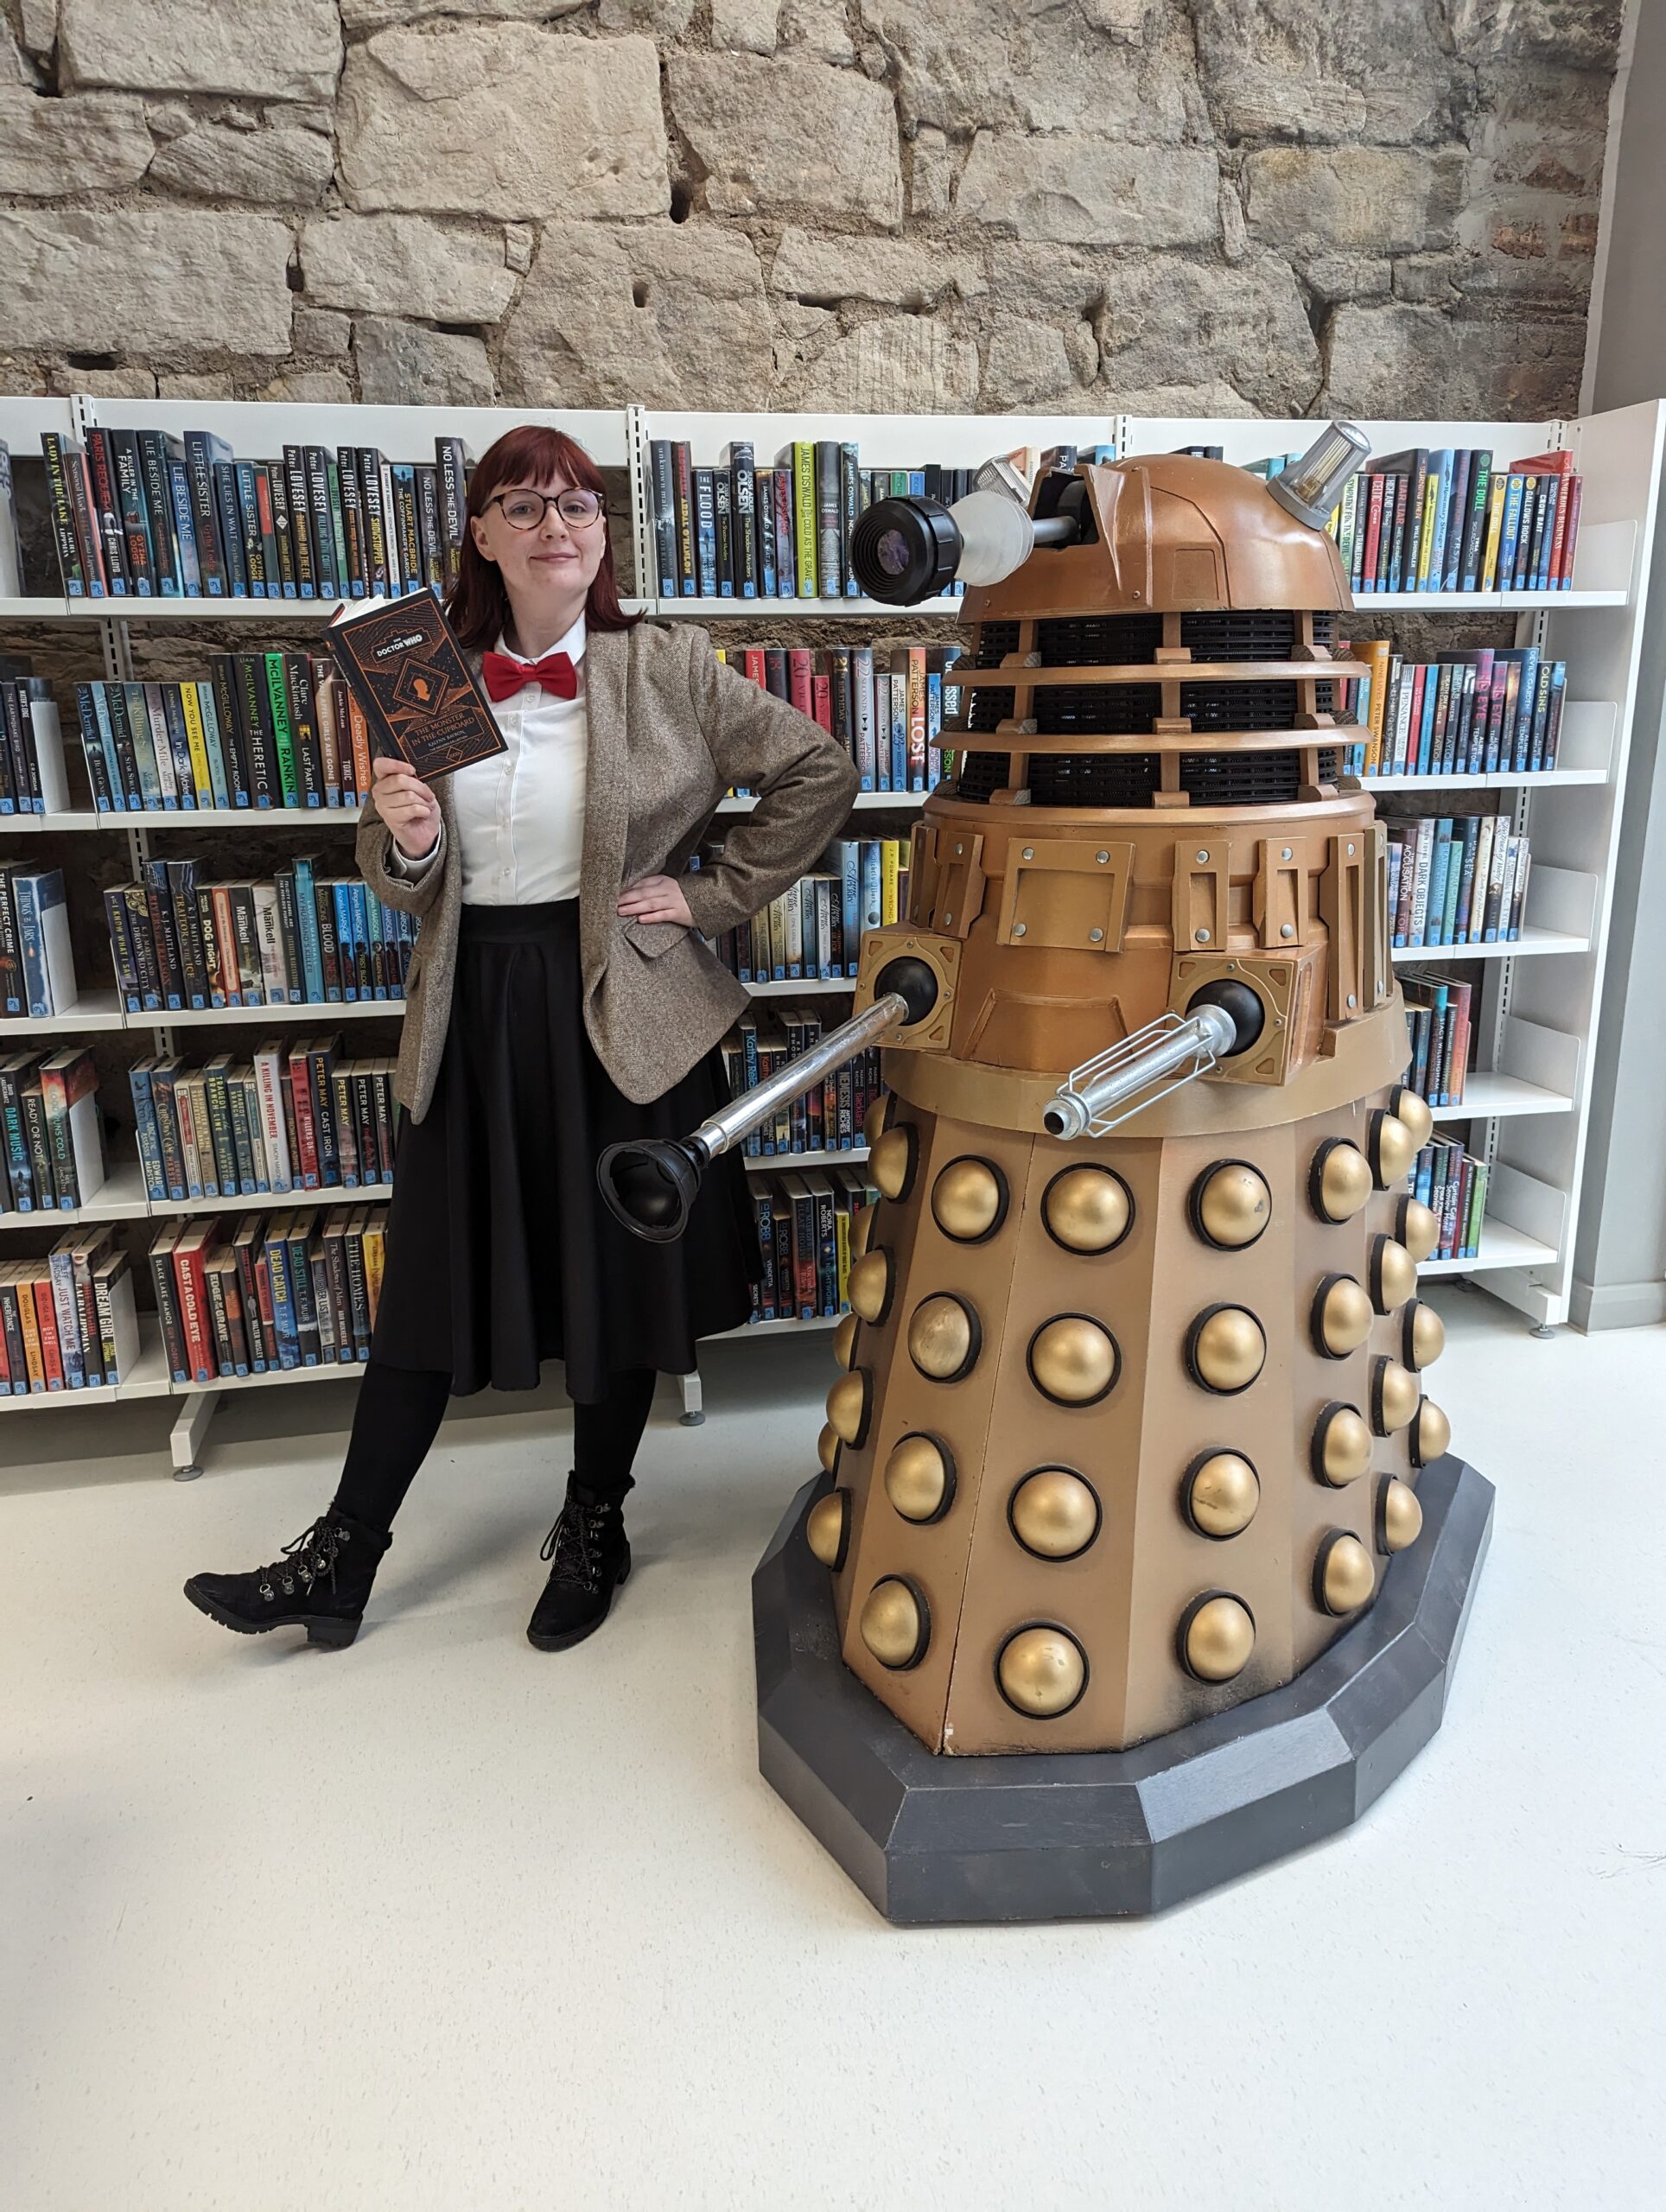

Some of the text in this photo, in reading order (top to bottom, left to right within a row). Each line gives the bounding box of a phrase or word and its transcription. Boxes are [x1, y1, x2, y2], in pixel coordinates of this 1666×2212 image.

[47, 436, 57, 464] LADY
[91, 433, 104, 465] PARIS
[145, 441, 154, 457] LIE
[442, 446, 452, 463] NO
[118, 455, 130, 493] FAMILY
[147, 460, 159, 496] BESIDE
[173, 467, 182, 480] LIE
[192, 442, 210, 517] LITTLE SISTER
[290, 471, 306, 512] LOVESEY
[342, 469, 356, 509] LOVESEY
[443, 467, 455, 490] LESS
[738, 470, 748, 514] OLSEN
[800, 447, 811, 507] JAMES OSWALD
[1371, 481, 1383, 502] CELTIC
[1474, 470, 1488, 512] THE DOLL
[154, 499, 163, 515] ME
[176, 484, 188, 520] BESIDE
[242, 470, 257, 536] LITTLE SISTER
[274, 480, 285, 510] LOVESEY
[311, 473, 327, 513] LOVESEY
[365, 474, 380, 517] LOVESEY
[700, 486, 712, 530] FLOOD
[1384, 480, 1395, 507] HIGHLAND
[1396, 479, 1408, 524] LIAR LIAR
[1523, 491, 1534, 524] GALLOWS
[1555, 473, 1569, 550] DANGEROUS BUSINESS
[181, 524, 192, 539] ME
[404, 493, 416, 574] STUART MACBRIDE
[424, 491, 436, 555] LESS DEVIL
[448, 507, 459, 539] DEVIL
[1506, 493, 1518, 540] THE FALLOUT
[371, 518, 383, 564] SHOWSTOPPER
[1353, 535, 1364, 573] TRAWLERMAN
[1453, 537, 1462, 563] YRSA
[377, 634, 423, 658] DOCTOR WHO
[857, 658, 870, 677] 22
[1541, 666, 1550, 691] OLD
[289, 664, 302, 720] Mackintosh
[299, 679, 308, 705] Clare
[1476, 696, 1487, 720] EYE
[151, 705, 162, 746] Murder
[411, 718, 474, 747] IN THE CUPBOARD
[414, 714, 465, 735] THE MONSTER
[911, 717, 925, 761] LOST
[252, 738, 268, 789] HERETIC
[354, 715, 367, 786] Deadly Wishes
[281, 748, 296, 792] RANKIN
[305, 766, 314, 791] PARTY
[343, 760, 352, 780] TOXIC
[1400, 844, 1412, 900] ACCUSATION
[1415, 861, 1428, 925] DARK OBJECTS
[5, 922, 14, 953] CRIME
[190, 921, 201, 965] MAITLAND
[237, 906, 250, 943] Mankell
[263, 907, 276, 944] Mankell
[321, 924, 334, 952] BLOOD
[112, 911, 131, 978] KNOW WHAT SAW
[163, 924, 175, 969] MAITLAND
[203, 919, 216, 968] DOG FIGHT
[747, 1036, 757, 1065] Kathy
[215, 1077, 227, 1109] TRAGEDY
[261, 1067, 273, 1097] KILLING
[358, 1079, 366, 1105] PETER
[375, 1077, 385, 1104] PETER
[839, 1072, 850, 1107] NEMESIS
[208, 1077, 222, 1131] BRANCH LINE
[316, 1058, 333, 1157] PETER MAY CAST IRON
[338, 1080, 349, 1126] PETER MAY
[378, 1106, 387, 1122] MAY
[5, 1108, 23, 1161] DARK MUSIC
[28, 1099, 43, 1160] READY OR NOT
[54, 1135, 65, 1160] COLD
[760, 1211, 771, 1240] ROBB
[270, 1249, 287, 1303] DEAD CATCH
[349, 1243, 365, 1312] THE HOMES
[22, 1294, 32, 1324] DOUGLAS
[59, 1286, 75, 1350] JUST WATCH ME
[94, 1283, 113, 1340] DREAM GIRL
[162, 1301, 173, 1325] MANOR
[180, 1260, 201, 1342] CAST COLD EYE
[217, 1309, 228, 1341] GRAVE
